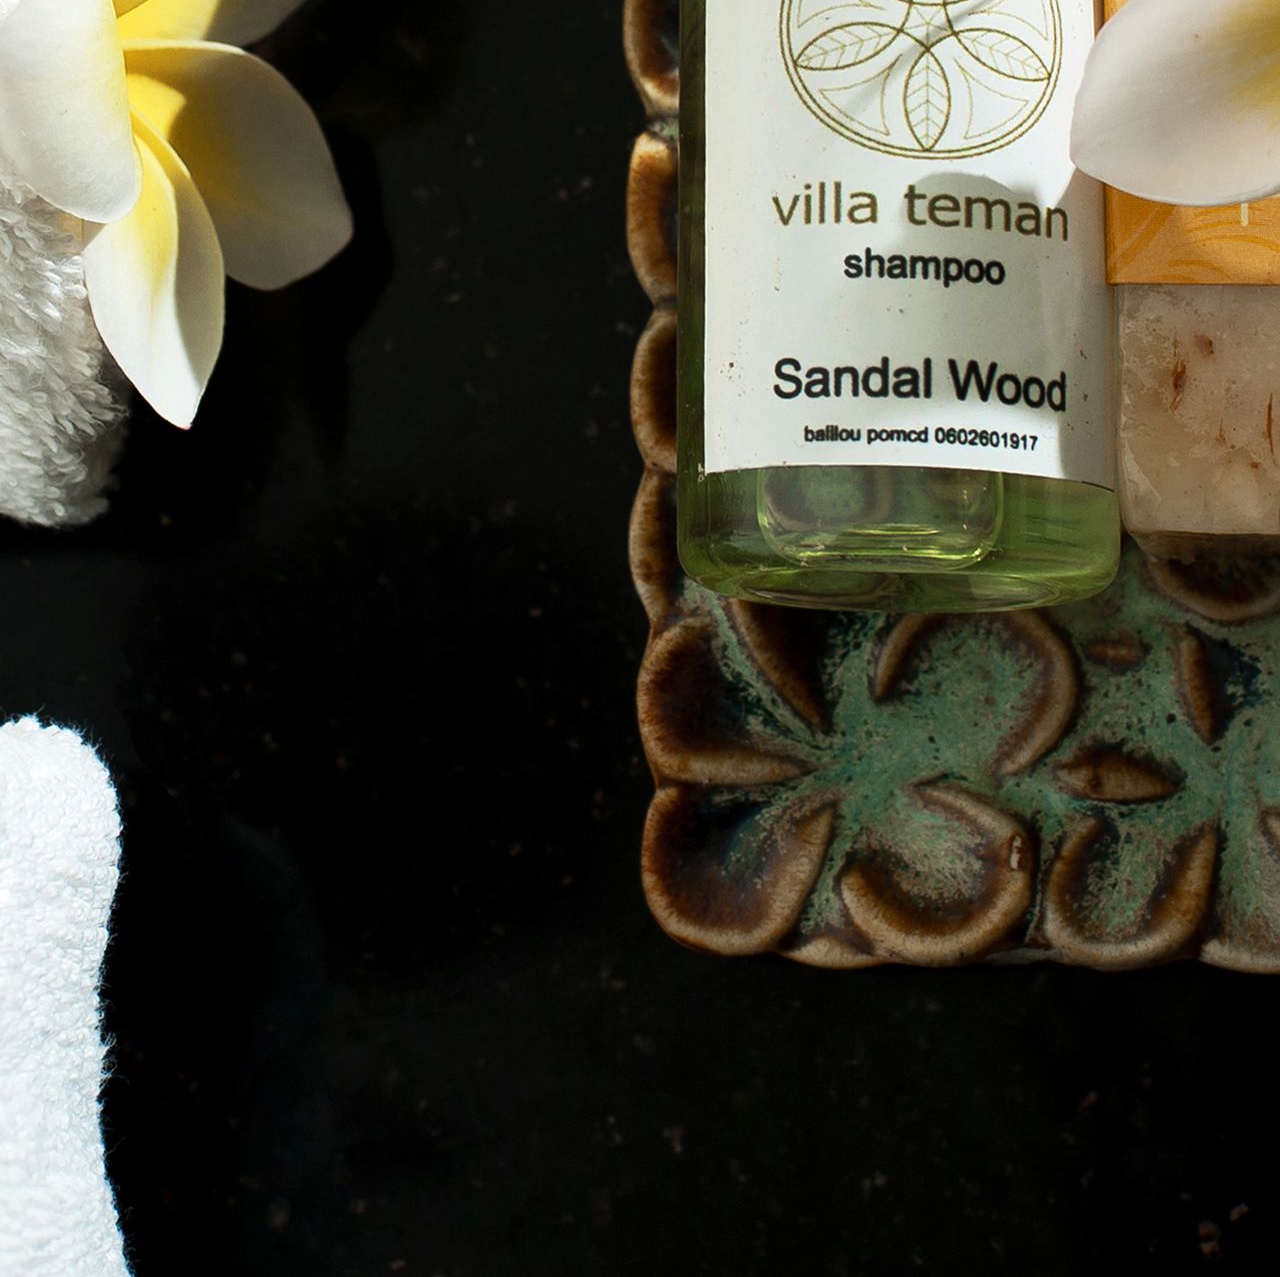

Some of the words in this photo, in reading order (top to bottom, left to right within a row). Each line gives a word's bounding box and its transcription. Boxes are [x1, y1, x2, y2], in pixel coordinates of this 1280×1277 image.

[771, 180, 879, 227] villa
[904, 180, 1070, 242] teman
[843, 247, 1007, 289] shampoo
[772, 356, 934, 400] Sandal
[947, 357, 1068, 413] Wood
[933, 426, 1039, 452] 0602601917
